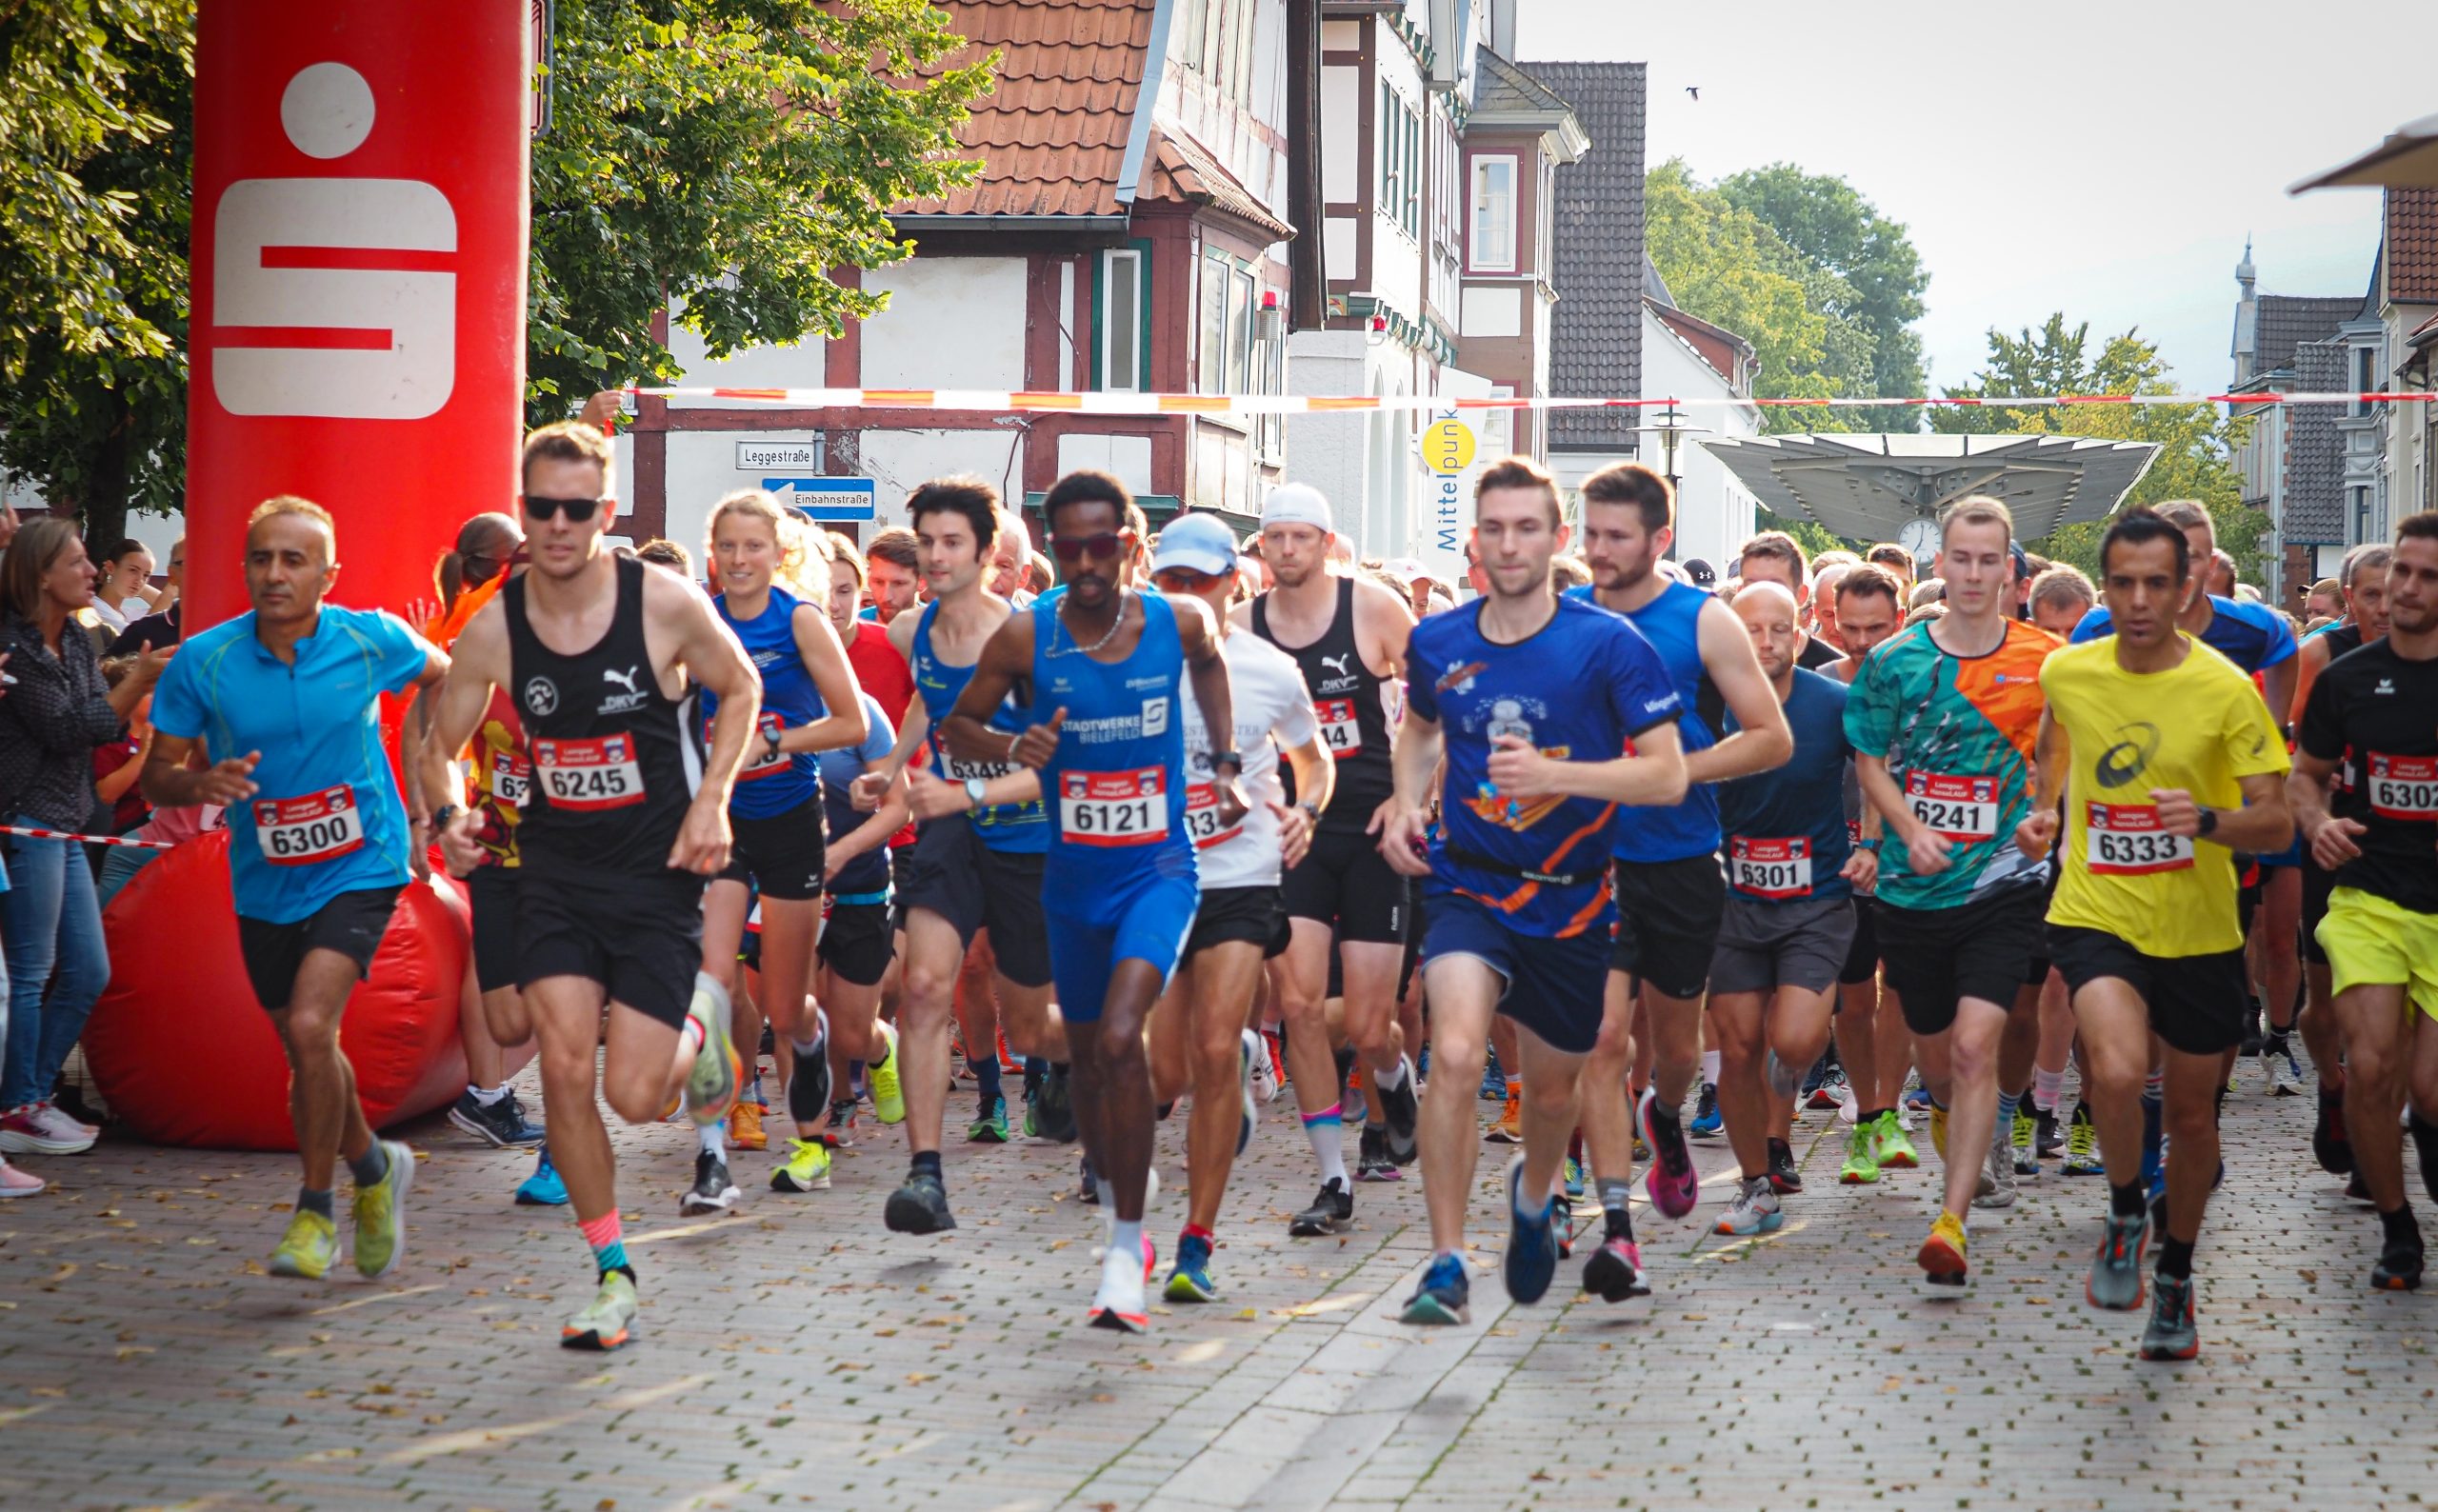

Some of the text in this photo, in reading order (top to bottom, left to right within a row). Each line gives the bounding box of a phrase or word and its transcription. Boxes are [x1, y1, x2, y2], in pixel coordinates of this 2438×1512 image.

[745, 448, 810, 466] Leggestraße
[1436, 408, 1463, 551] Mittelpunk
[795, 493, 869, 505] Einbahnstraße
[1061, 715, 1141, 732] STADTWERKE
[1079, 727, 1140, 744] BIELEFELD
[950, 758, 1011, 780] 6348
[550, 768, 627, 798] 6245
[1074, 801, 1149, 832] 6121
[1914, 800, 1980, 831] 6241
[270, 816, 349, 855] 6300
[2099, 833, 2178, 864] 6333
[1741, 863, 1797, 887] 6301
